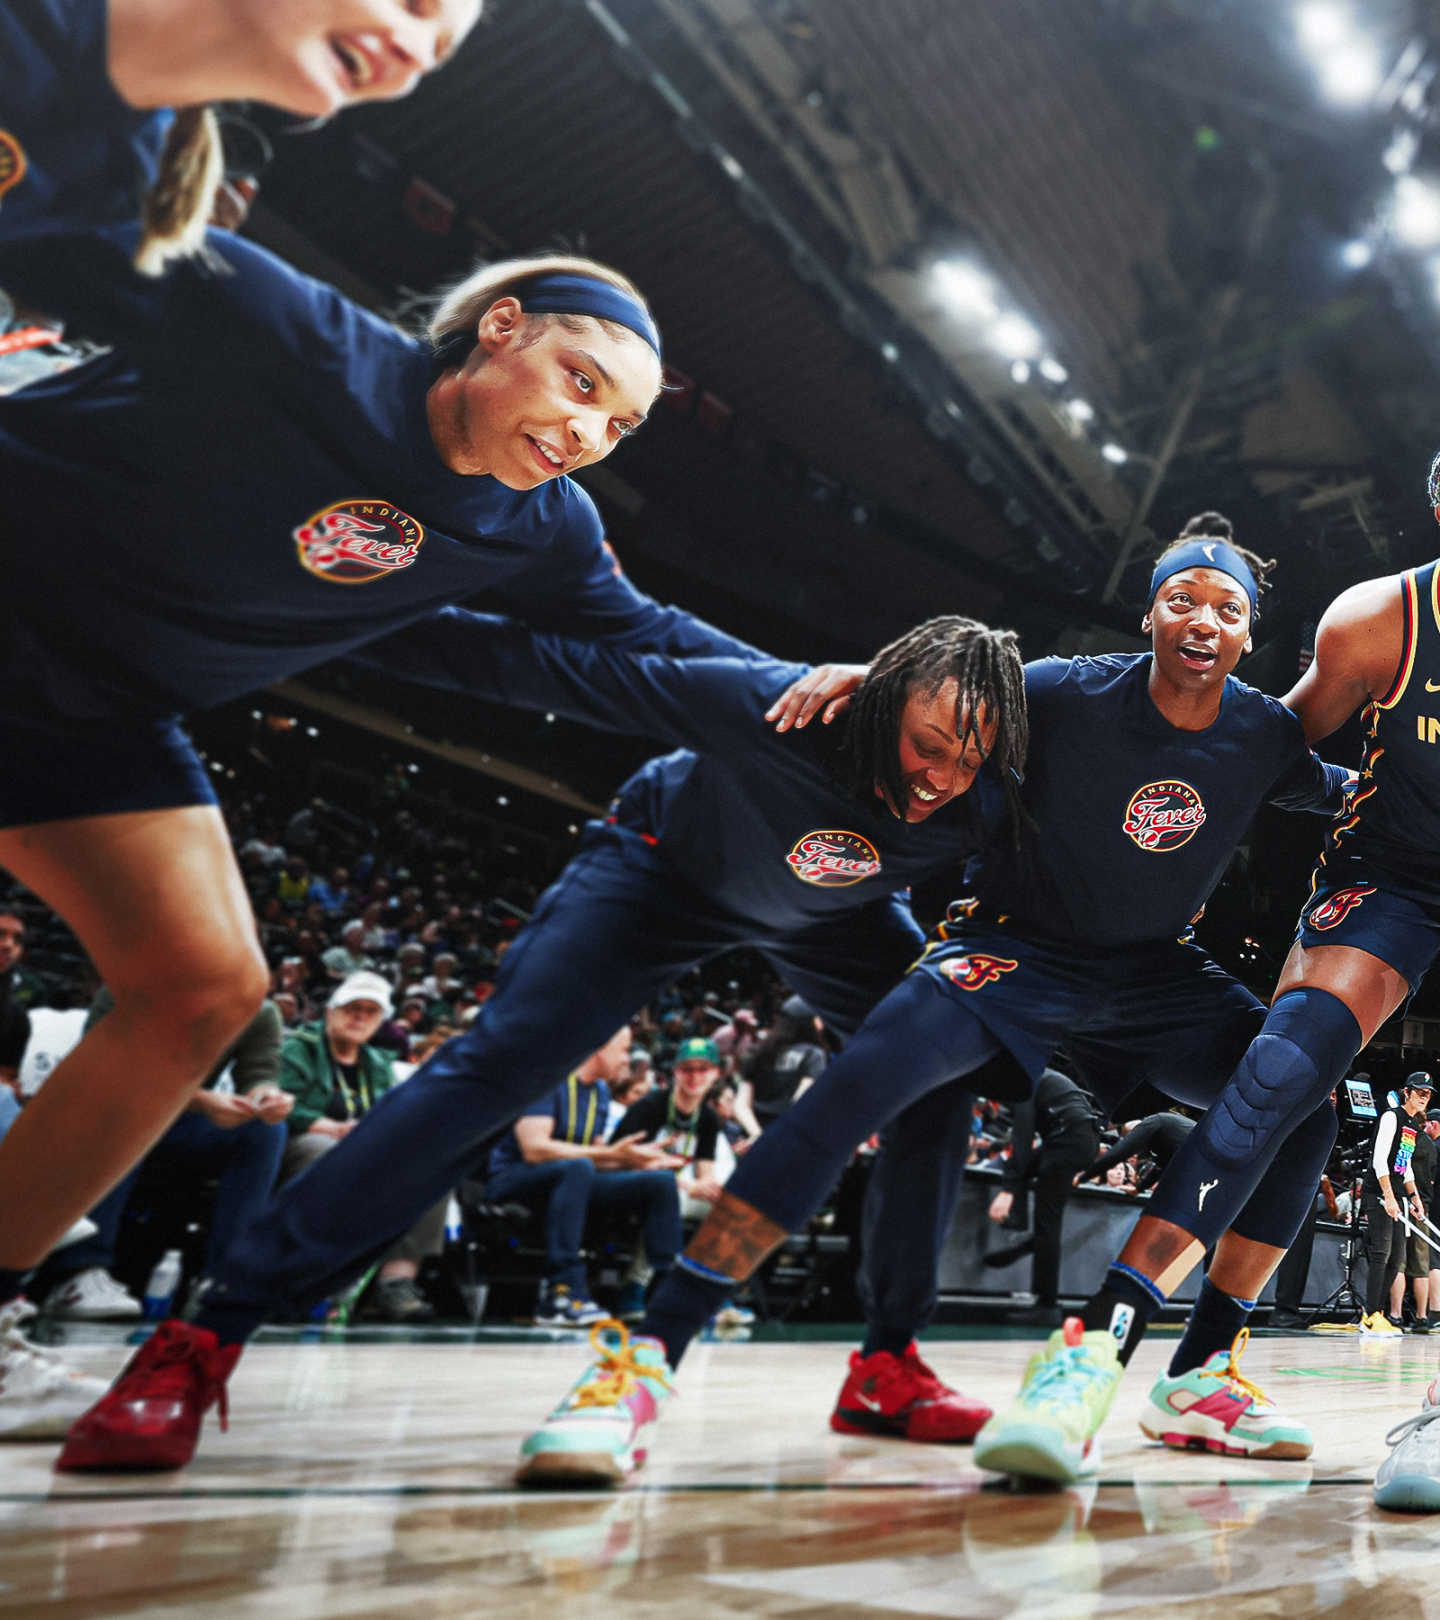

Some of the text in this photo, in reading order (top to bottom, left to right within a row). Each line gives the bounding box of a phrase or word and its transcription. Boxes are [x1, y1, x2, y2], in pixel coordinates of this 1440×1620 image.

[292, 512, 419, 570] Fever
[349, 505, 417, 545] INDIANA
[1140, 784, 1197, 807] INDIANA
[1122, 796, 1207, 834] Fever
[785, 840, 882, 877] Fever
[816, 834, 873, 861] INDIANA
